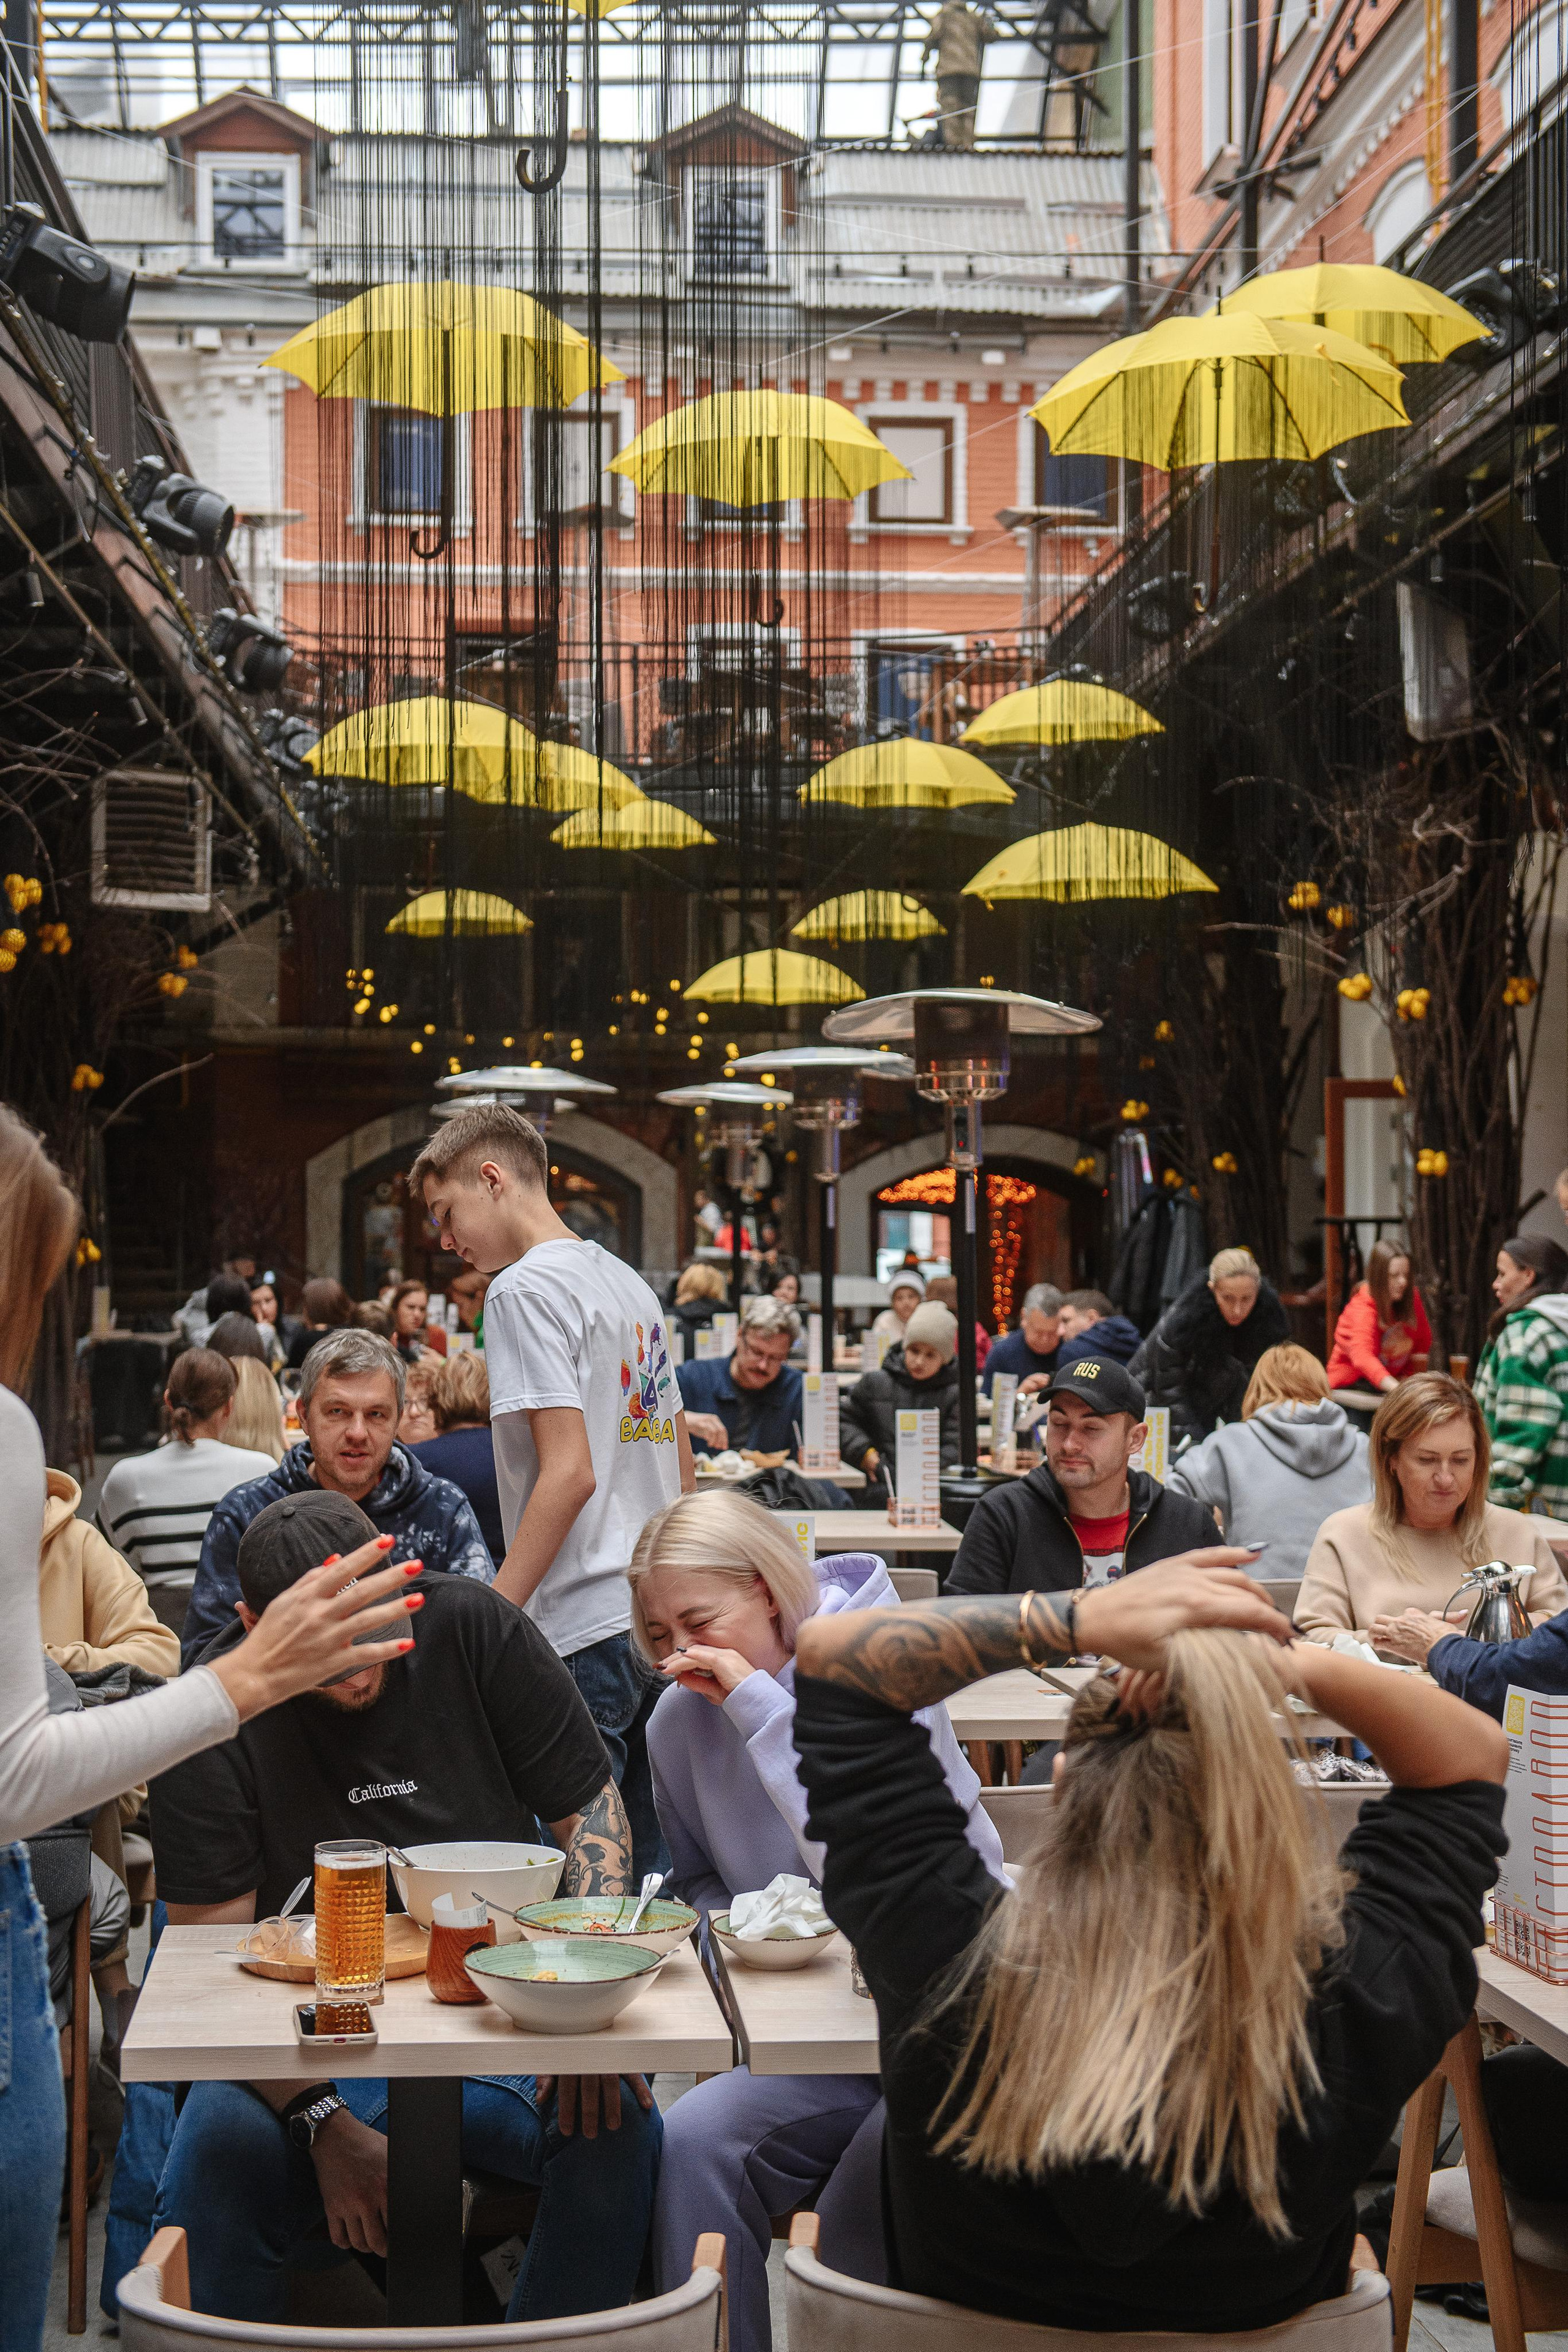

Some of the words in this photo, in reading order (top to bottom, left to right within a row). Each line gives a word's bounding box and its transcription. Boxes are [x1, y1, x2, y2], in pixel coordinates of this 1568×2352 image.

[1073, 1362, 1101, 1379] RUS
[620, 1416, 674, 1444] BABA
[349, 1779, 418, 1803] California
